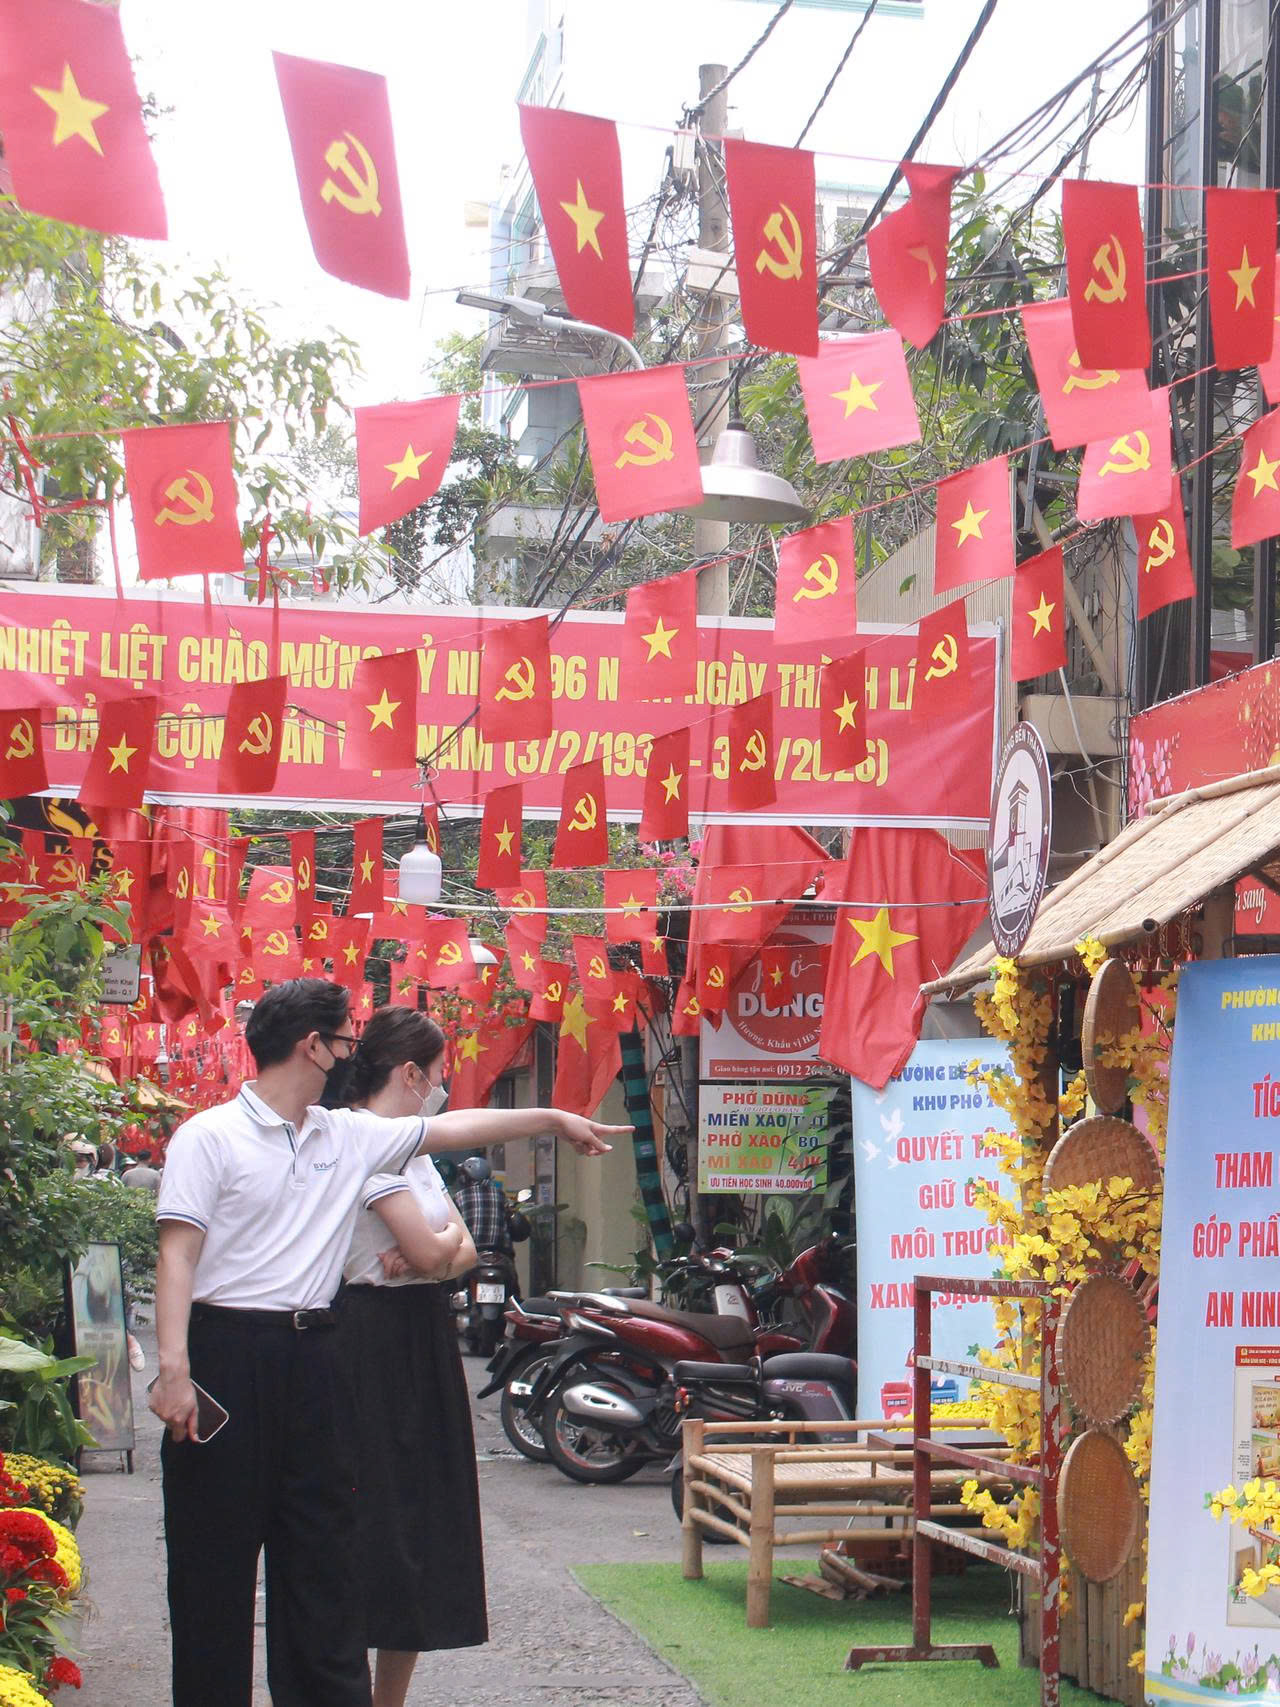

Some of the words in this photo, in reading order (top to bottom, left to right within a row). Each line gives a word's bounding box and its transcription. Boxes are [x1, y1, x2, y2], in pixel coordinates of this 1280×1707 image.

[0, 619, 90, 685] NHIỆT
[101, 623, 168, 689] LIỆT
[178, 628, 268, 684] CHÀO
[280, 634, 382, 689] MỪN
[157, 703, 225, 769] CỘN
[279, 703, 325, 764] ẢN
[416, 724, 493, 771] NAM
[777, 1064, 802, 1076] 0912
[913, 1095, 946, 1111] KHU
[707, 1131, 742, 1147] PHỞ
[896, 1130, 964, 1163] QUYẾT
[755, 1178, 772, 1188] SINH
[1215, 1152, 1272, 1188] THAM
[919, 1179, 957, 1209] GIỮ
[891, 1226, 935, 1260] MÔI
[1193, 1213, 1232, 1258] GÓP
[1205, 1291, 1234, 1327] AN
[781, 1385, 803, 1393] JVC
